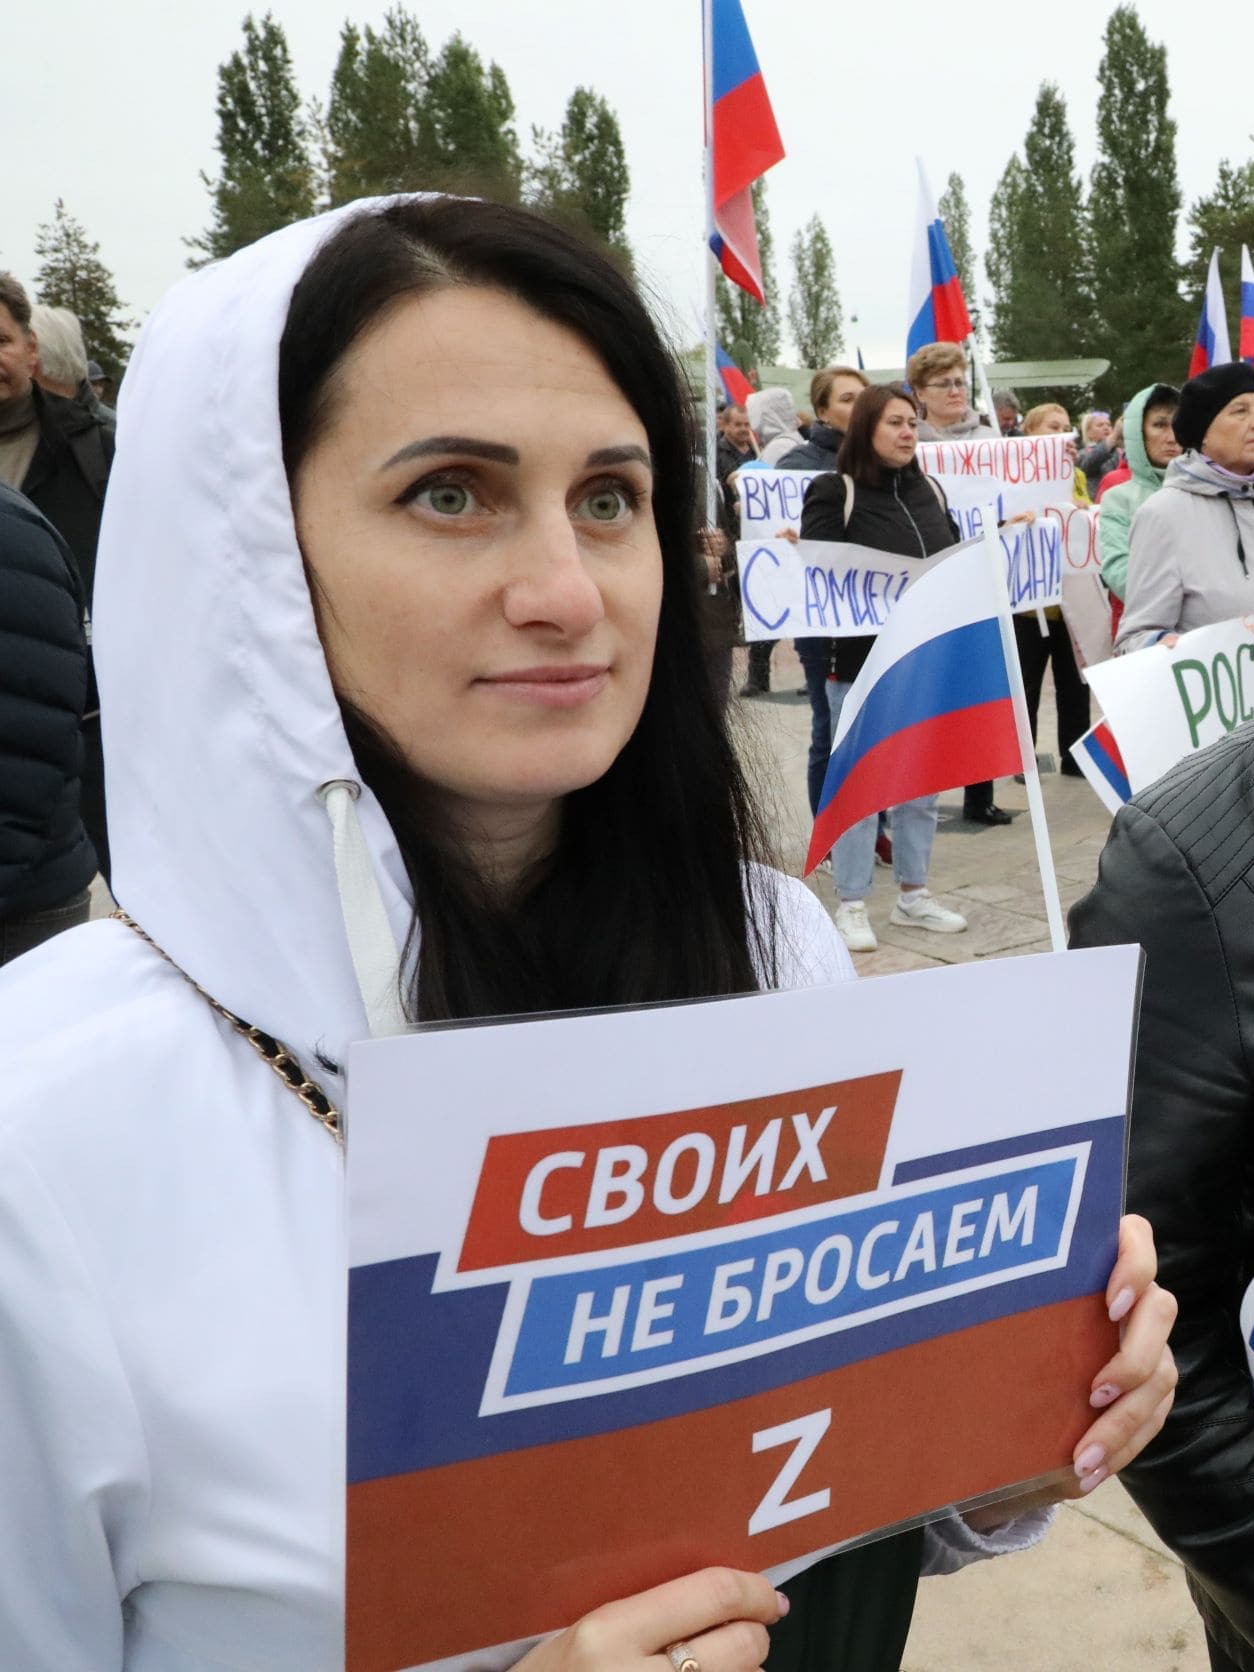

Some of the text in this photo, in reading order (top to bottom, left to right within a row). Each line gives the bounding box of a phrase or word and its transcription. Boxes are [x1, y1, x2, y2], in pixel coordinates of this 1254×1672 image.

[743, 548, 790, 630] С
[518, 1105, 838, 1237] СВОИХ
[562, 1185, 1040, 1366] НЕ БРОСАЕМ
[748, 1408, 831, 1536] Z
